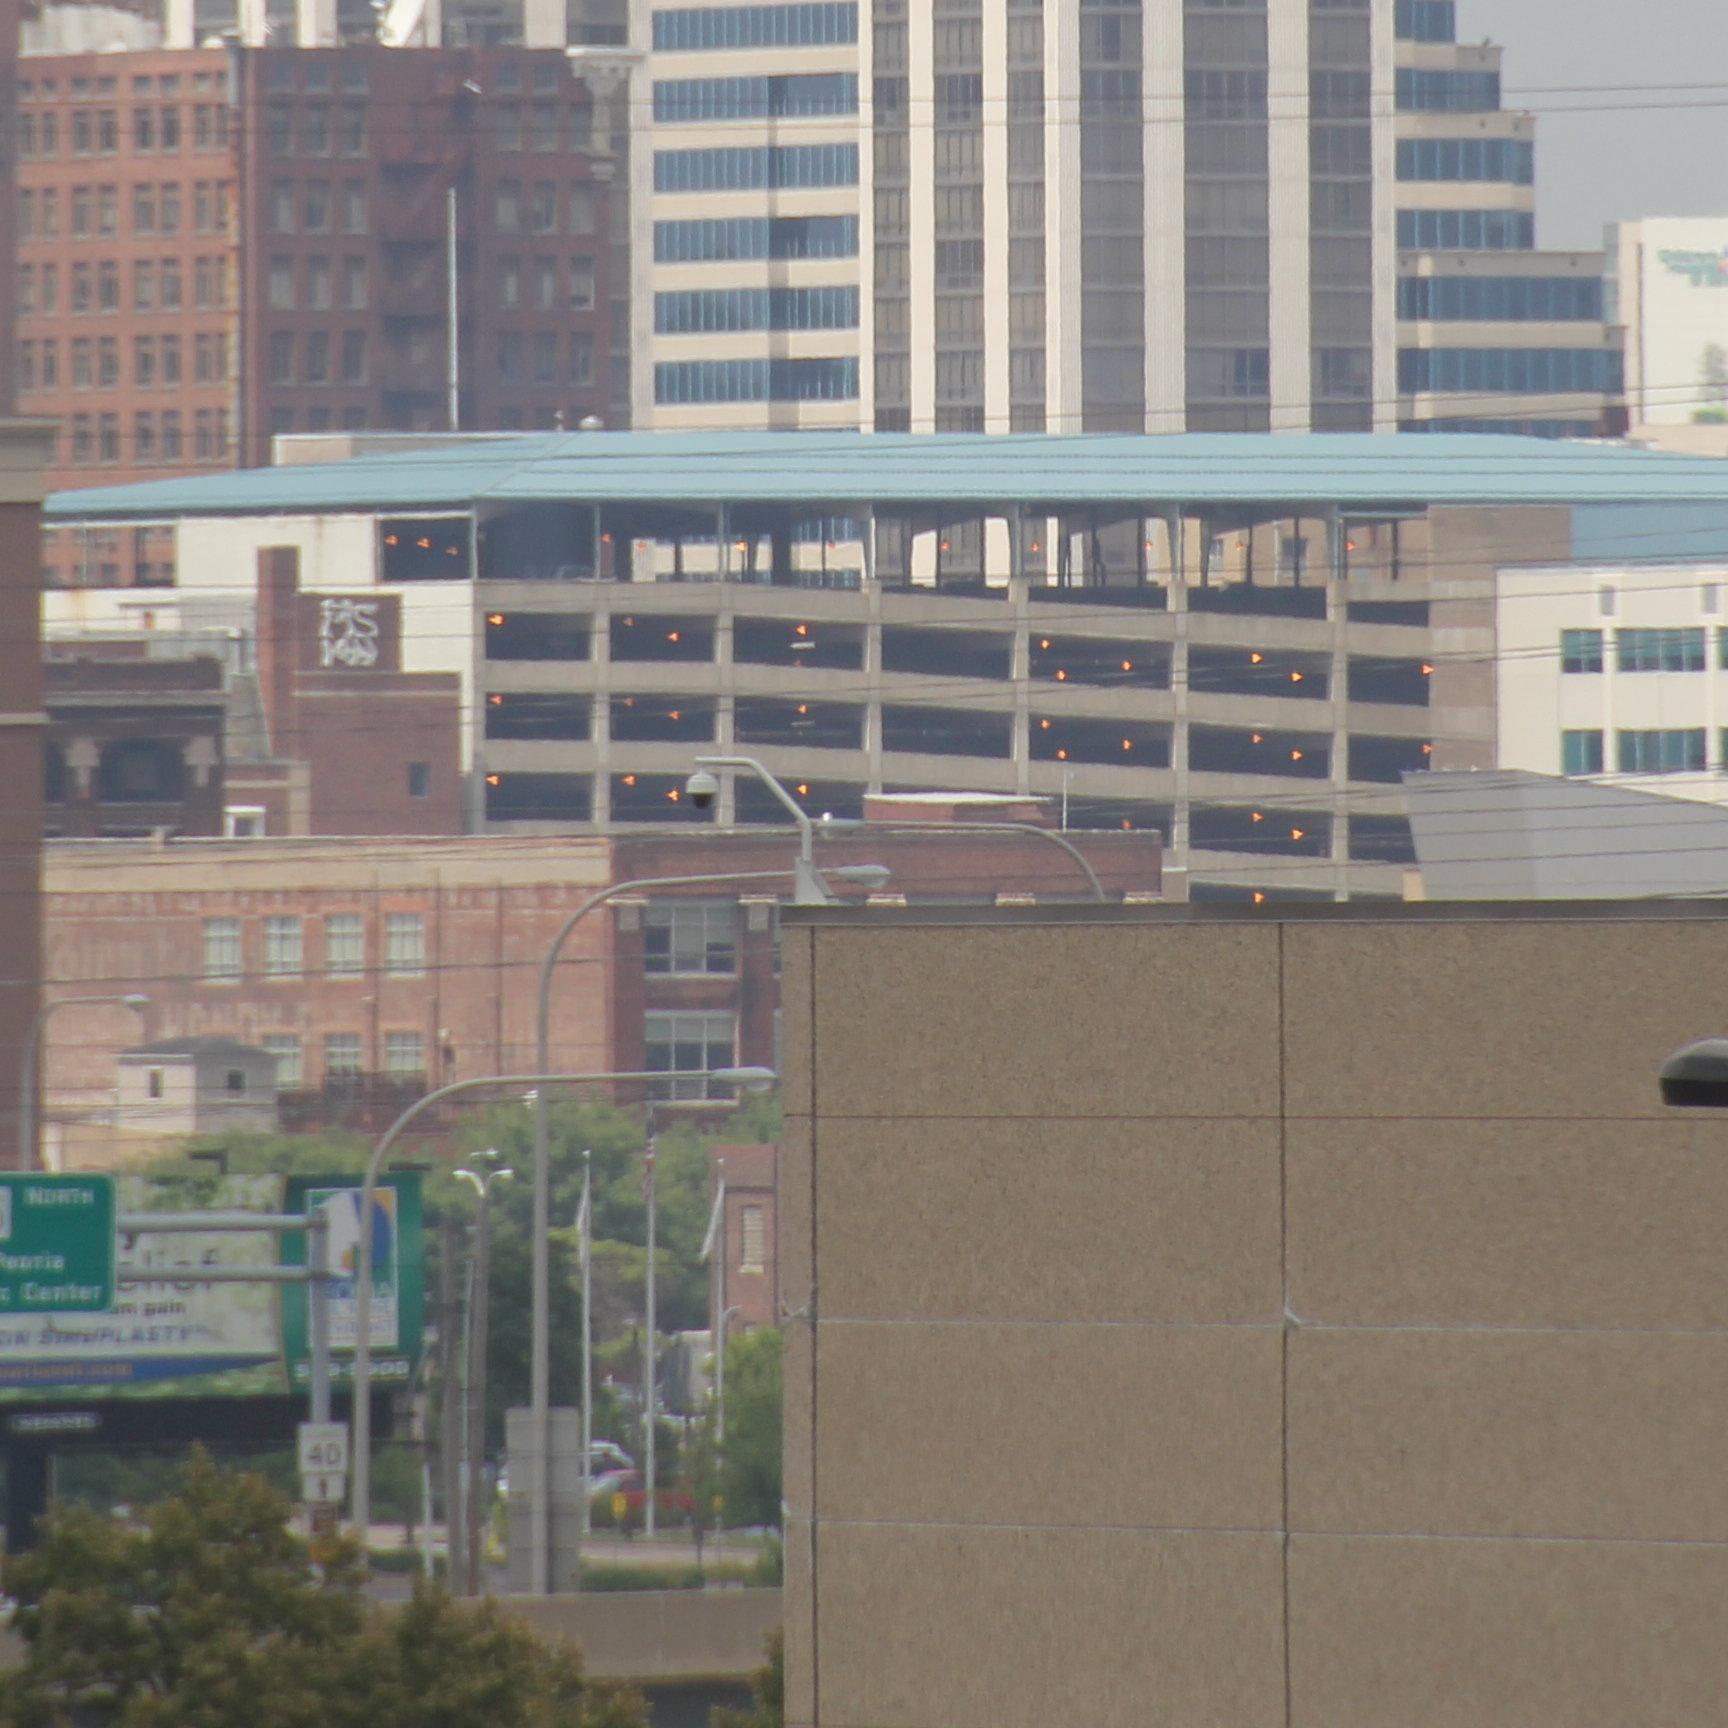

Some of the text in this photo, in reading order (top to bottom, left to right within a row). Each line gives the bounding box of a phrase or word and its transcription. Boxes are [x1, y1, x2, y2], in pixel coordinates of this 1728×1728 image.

[24, 1188, 93, 1203] NORTH
[20, 1282, 103, 1302] Center
[308, 1441, 342, 1465] 40
